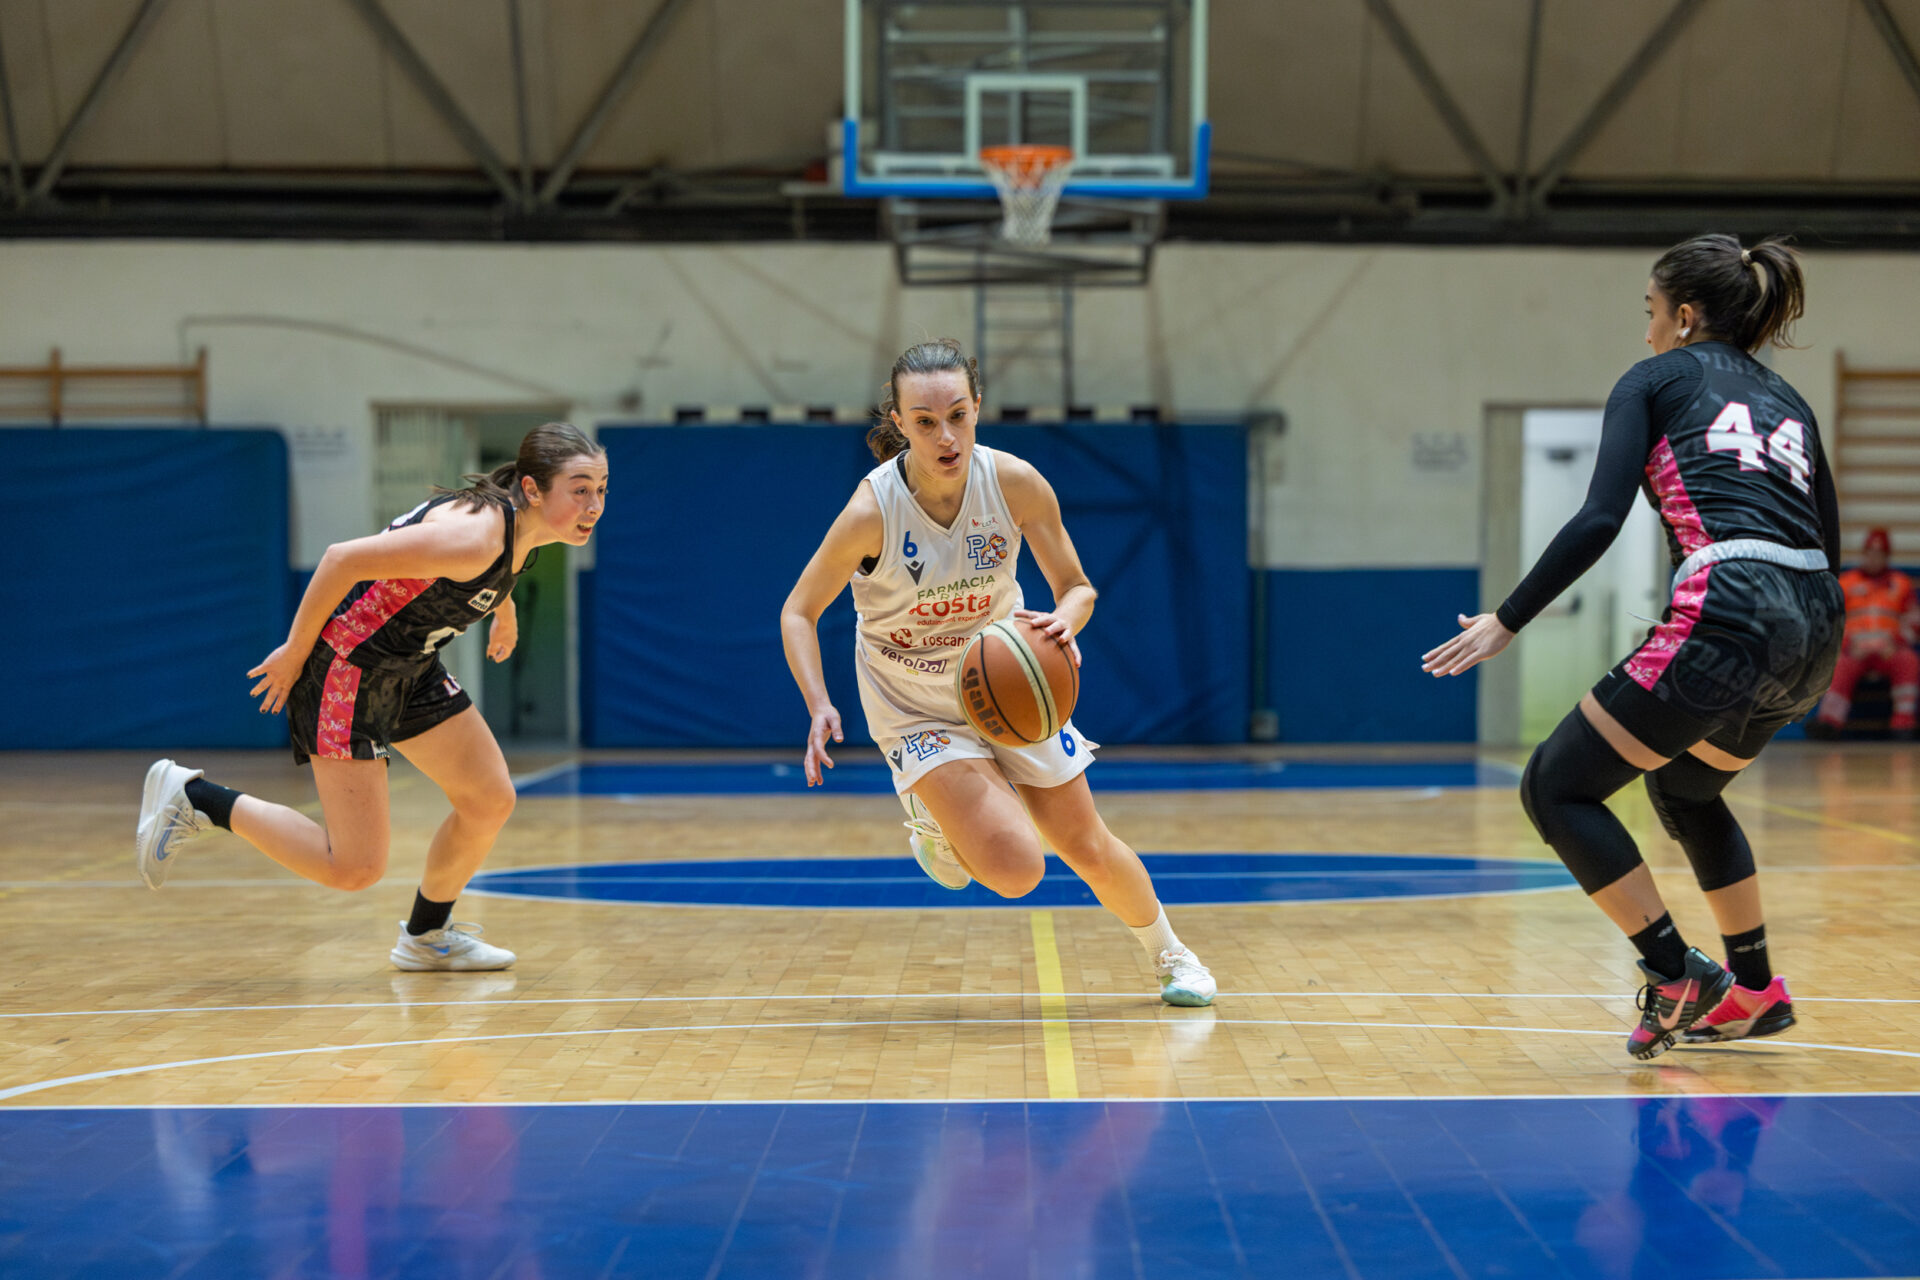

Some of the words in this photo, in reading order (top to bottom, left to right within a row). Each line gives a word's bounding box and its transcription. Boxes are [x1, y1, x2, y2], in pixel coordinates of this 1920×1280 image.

[1705, 401, 1811, 495] 44
[903, 530, 918, 558] 6
[918, 574, 995, 601] FARMACIA
[909, 593, 991, 617] costa
[1059, 728, 1076, 757] 6
